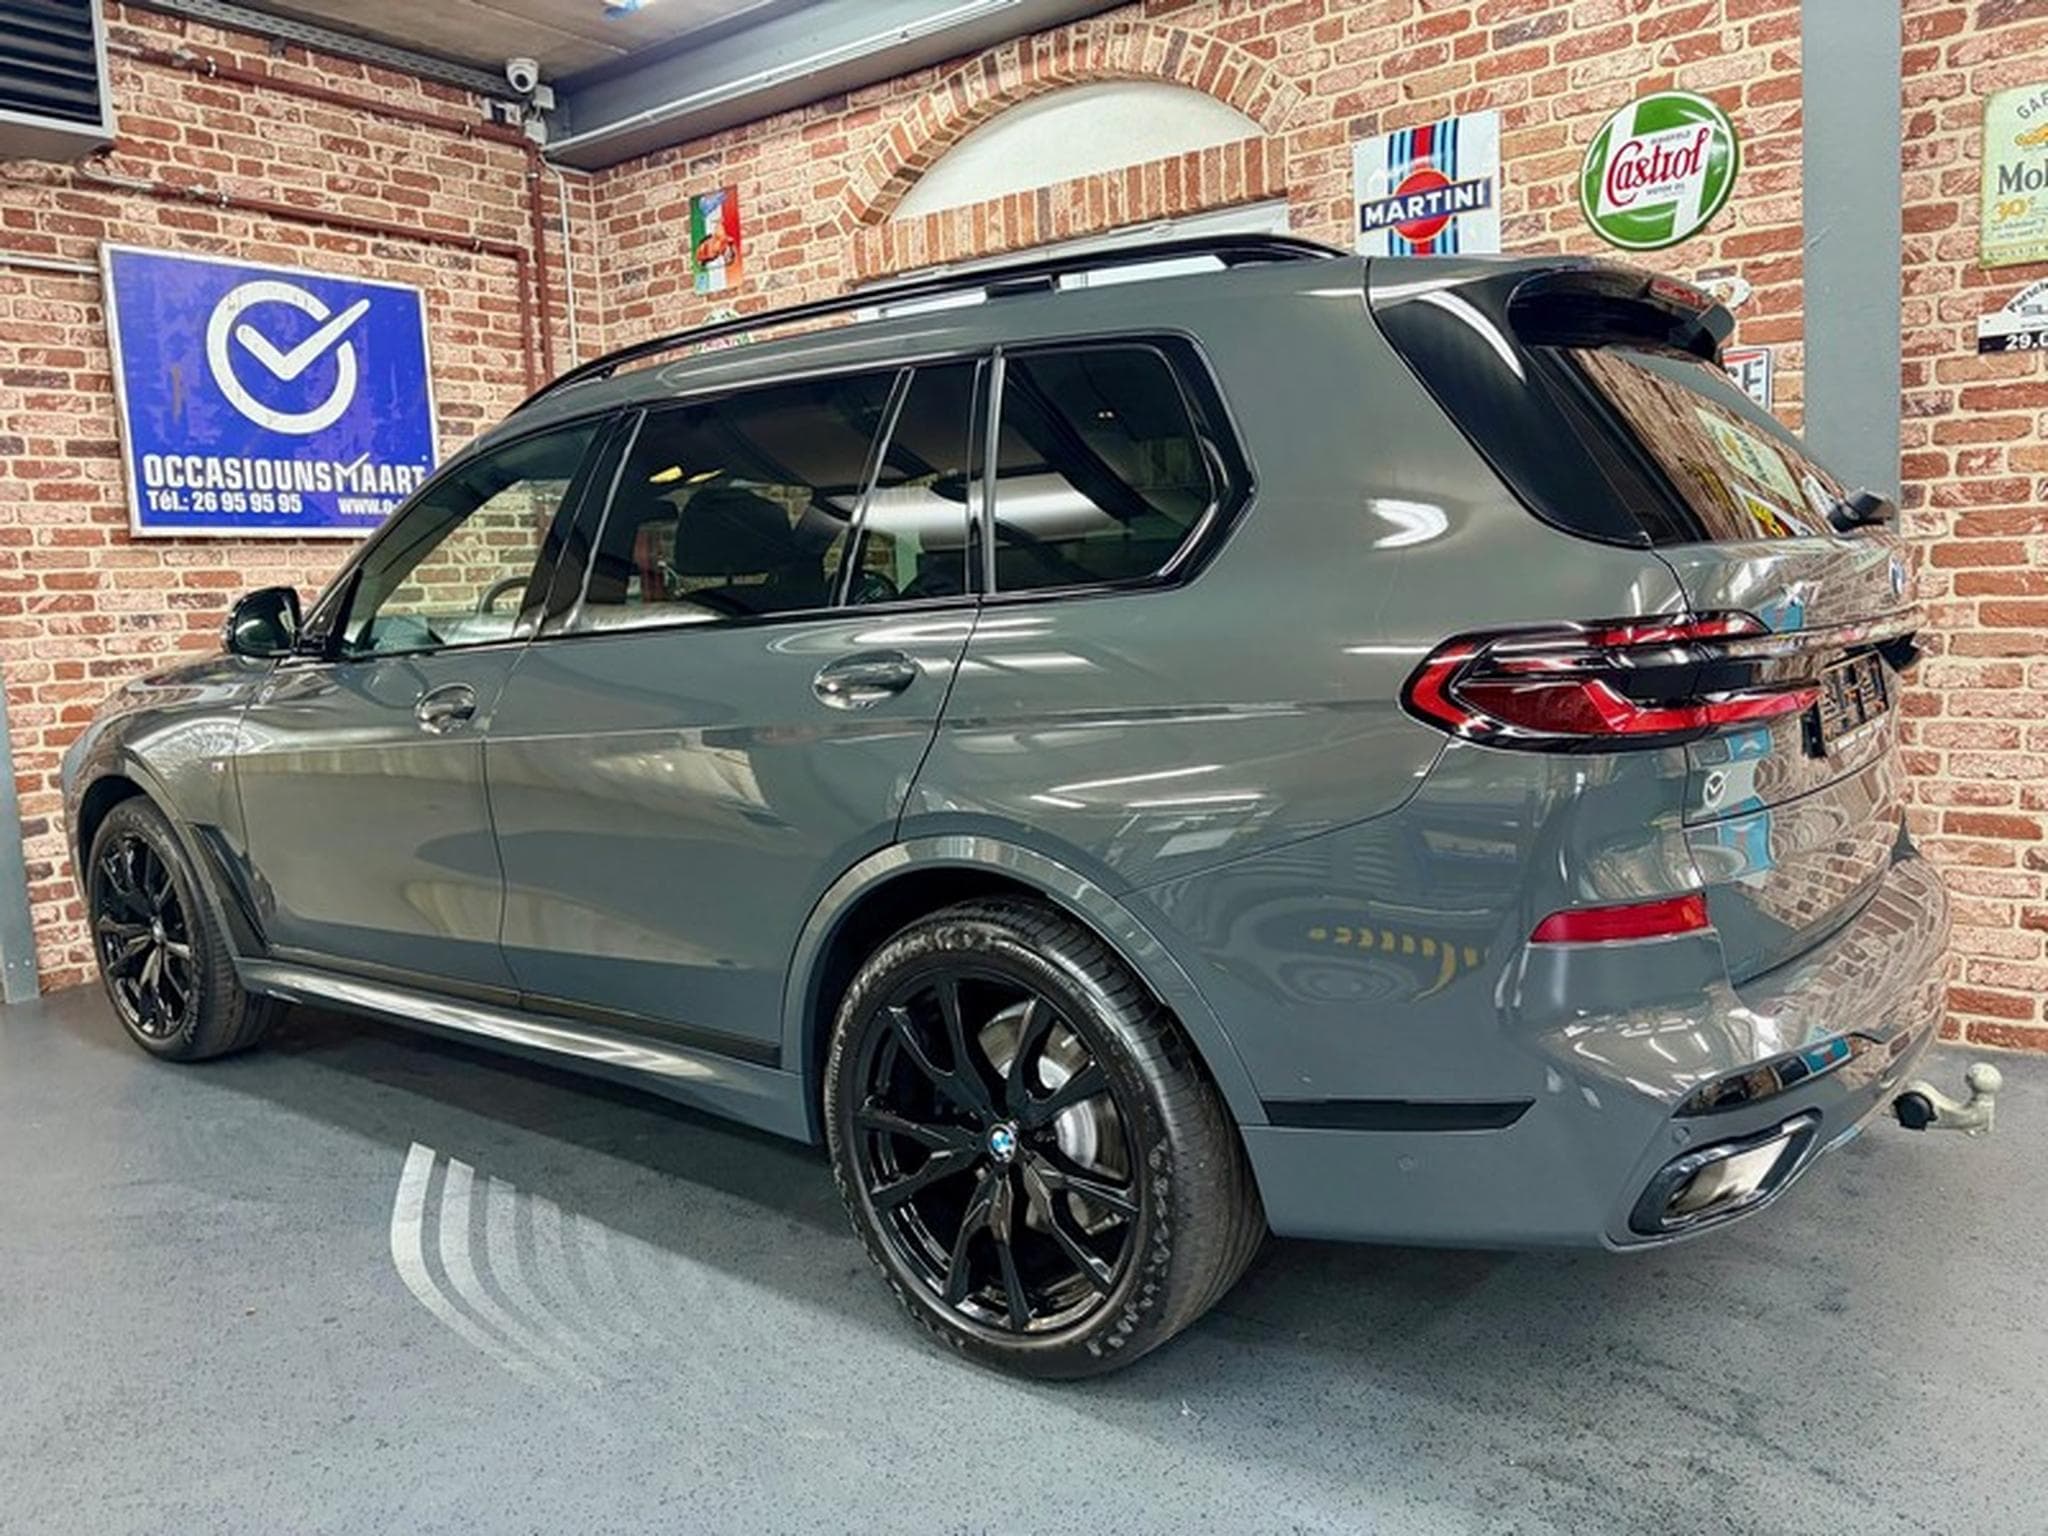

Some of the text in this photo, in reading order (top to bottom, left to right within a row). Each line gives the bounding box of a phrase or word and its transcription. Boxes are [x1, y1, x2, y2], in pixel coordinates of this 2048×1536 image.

[1606, 127, 1709, 207] Castrol
[1365, 183, 1483, 228] MARTINI
[143, 452, 426, 494] OCCASIOUNSMAART
[192, 491, 217, 512] 26
[221, 492, 246, 513] 95
[250, 493, 275, 513] 95
[278, 494, 303, 514] 95
